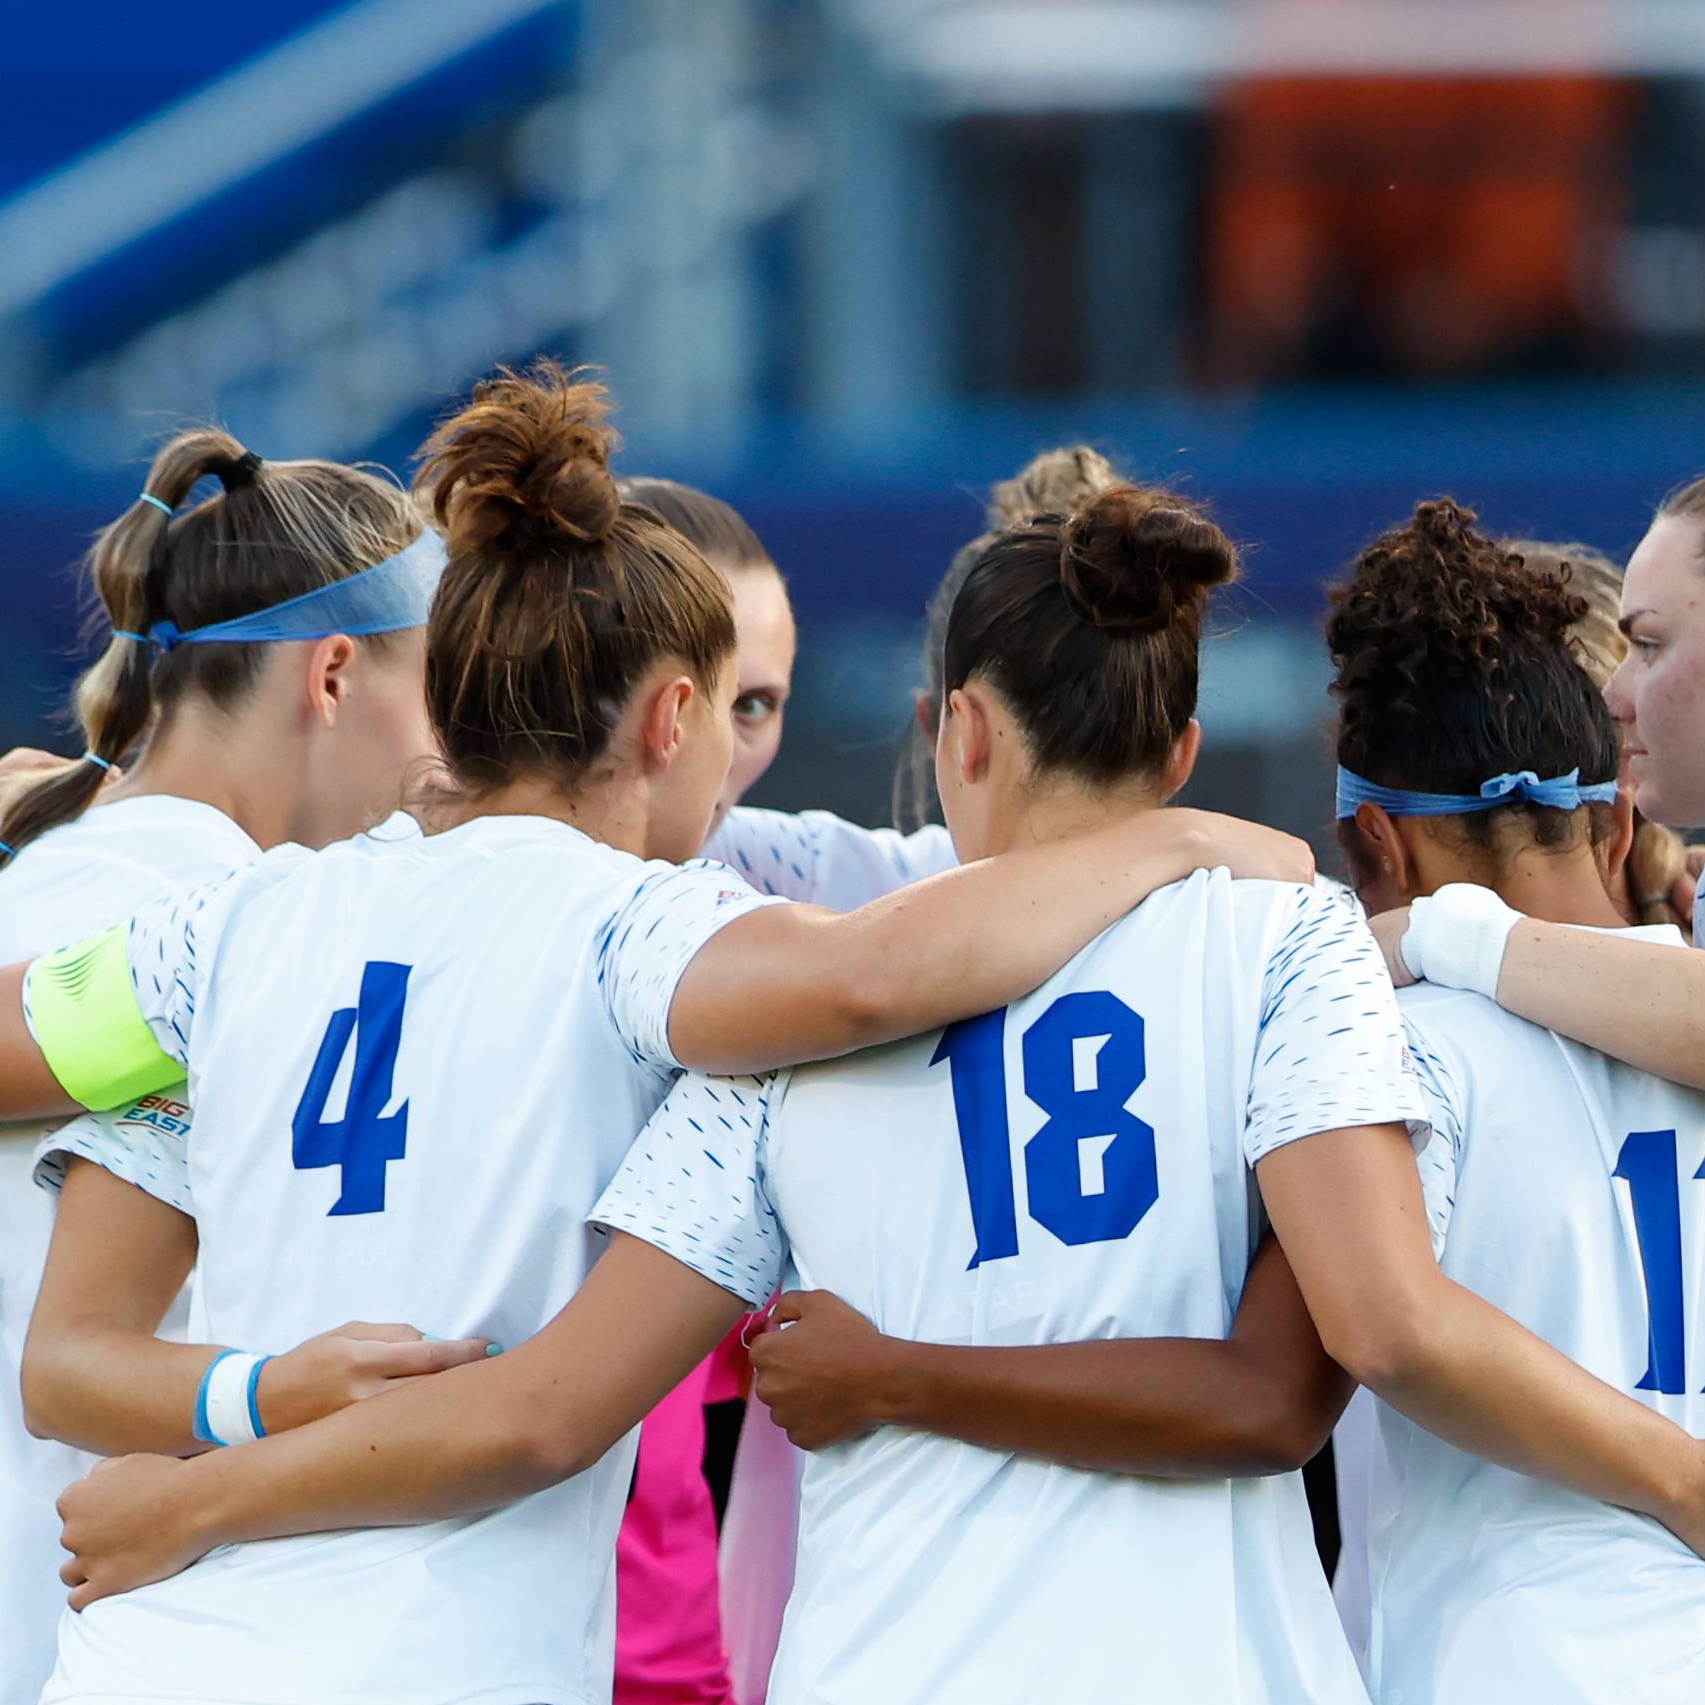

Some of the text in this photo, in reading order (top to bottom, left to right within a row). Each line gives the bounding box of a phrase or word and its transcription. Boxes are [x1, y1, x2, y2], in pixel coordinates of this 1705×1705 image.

[136, 1095, 191, 1117] BIG
[291, 960, 413, 1217] 4
[929, 989, 1160, 1271] 18
